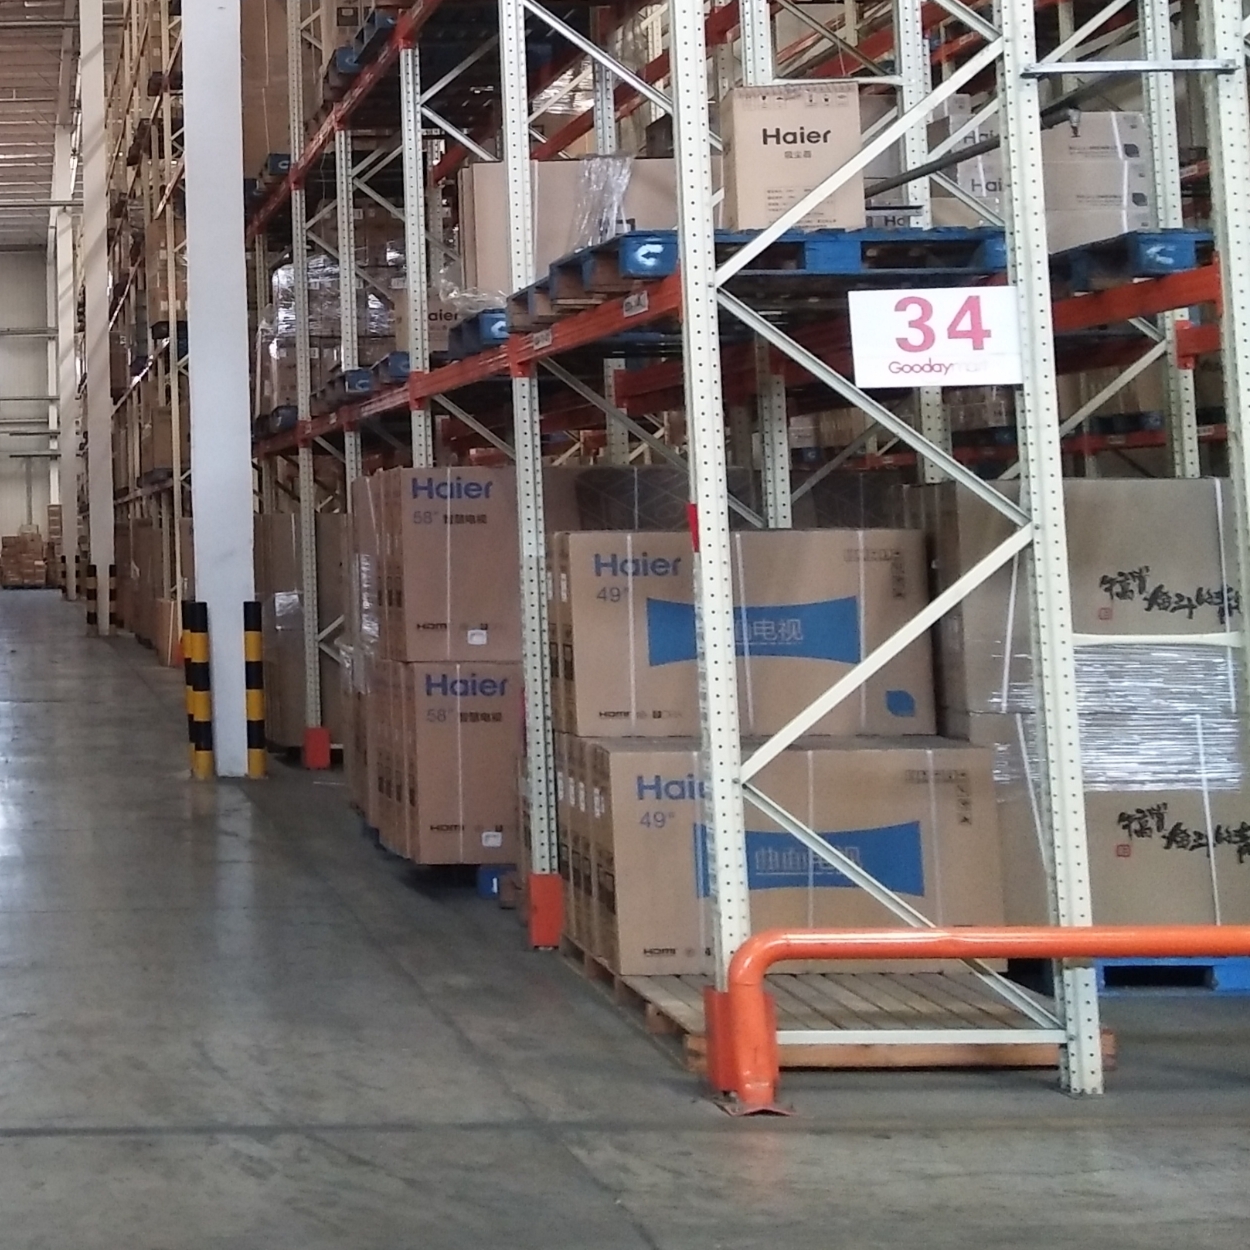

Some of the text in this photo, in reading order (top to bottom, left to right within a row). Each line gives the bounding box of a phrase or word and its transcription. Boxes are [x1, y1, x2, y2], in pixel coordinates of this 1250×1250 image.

[762, 126, 831, 146] Haier
[971, 178, 1002, 192] Hai
[428, 308, 459, 322] aier
[894, 295, 992, 353] 34
[412, 476, 493, 499] Haier
[594, 552, 682, 577] Haier
[734, 618, 804, 642] 电视
[425, 673, 508, 697] Haier
[637, 774, 706, 801] Hai
